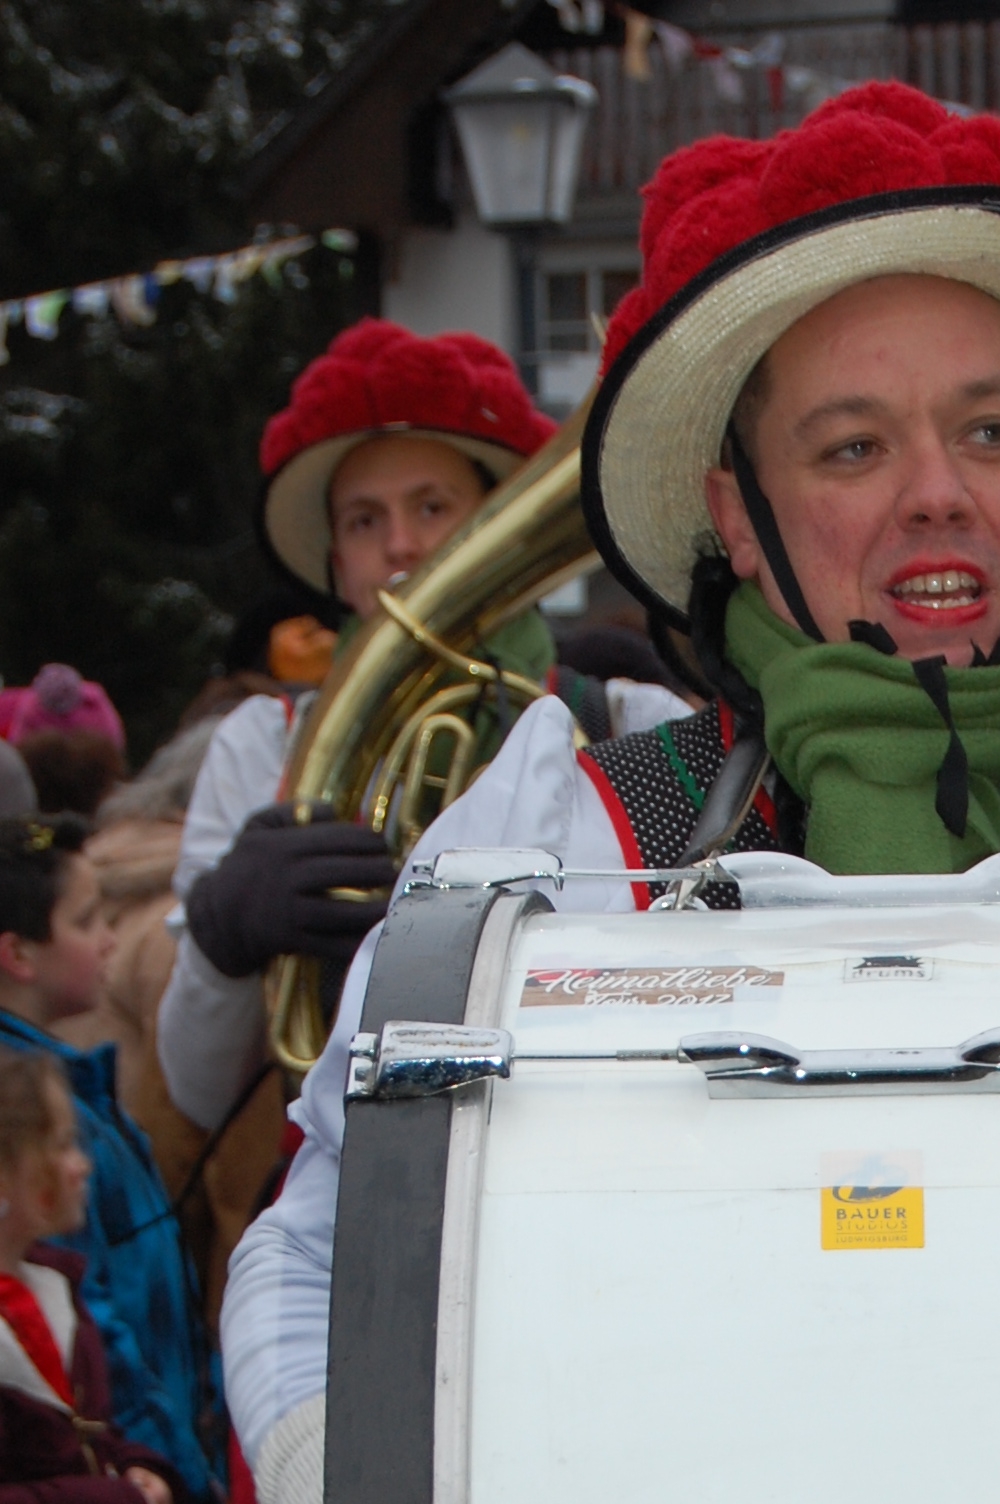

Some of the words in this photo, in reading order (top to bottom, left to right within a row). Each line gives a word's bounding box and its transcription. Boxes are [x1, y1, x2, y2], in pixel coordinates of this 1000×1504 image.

[528, 967, 770, 994] Heimatliebe
[836, 1207, 907, 1220] BAUER
[836, 1220, 908, 1231] STUDIOS
